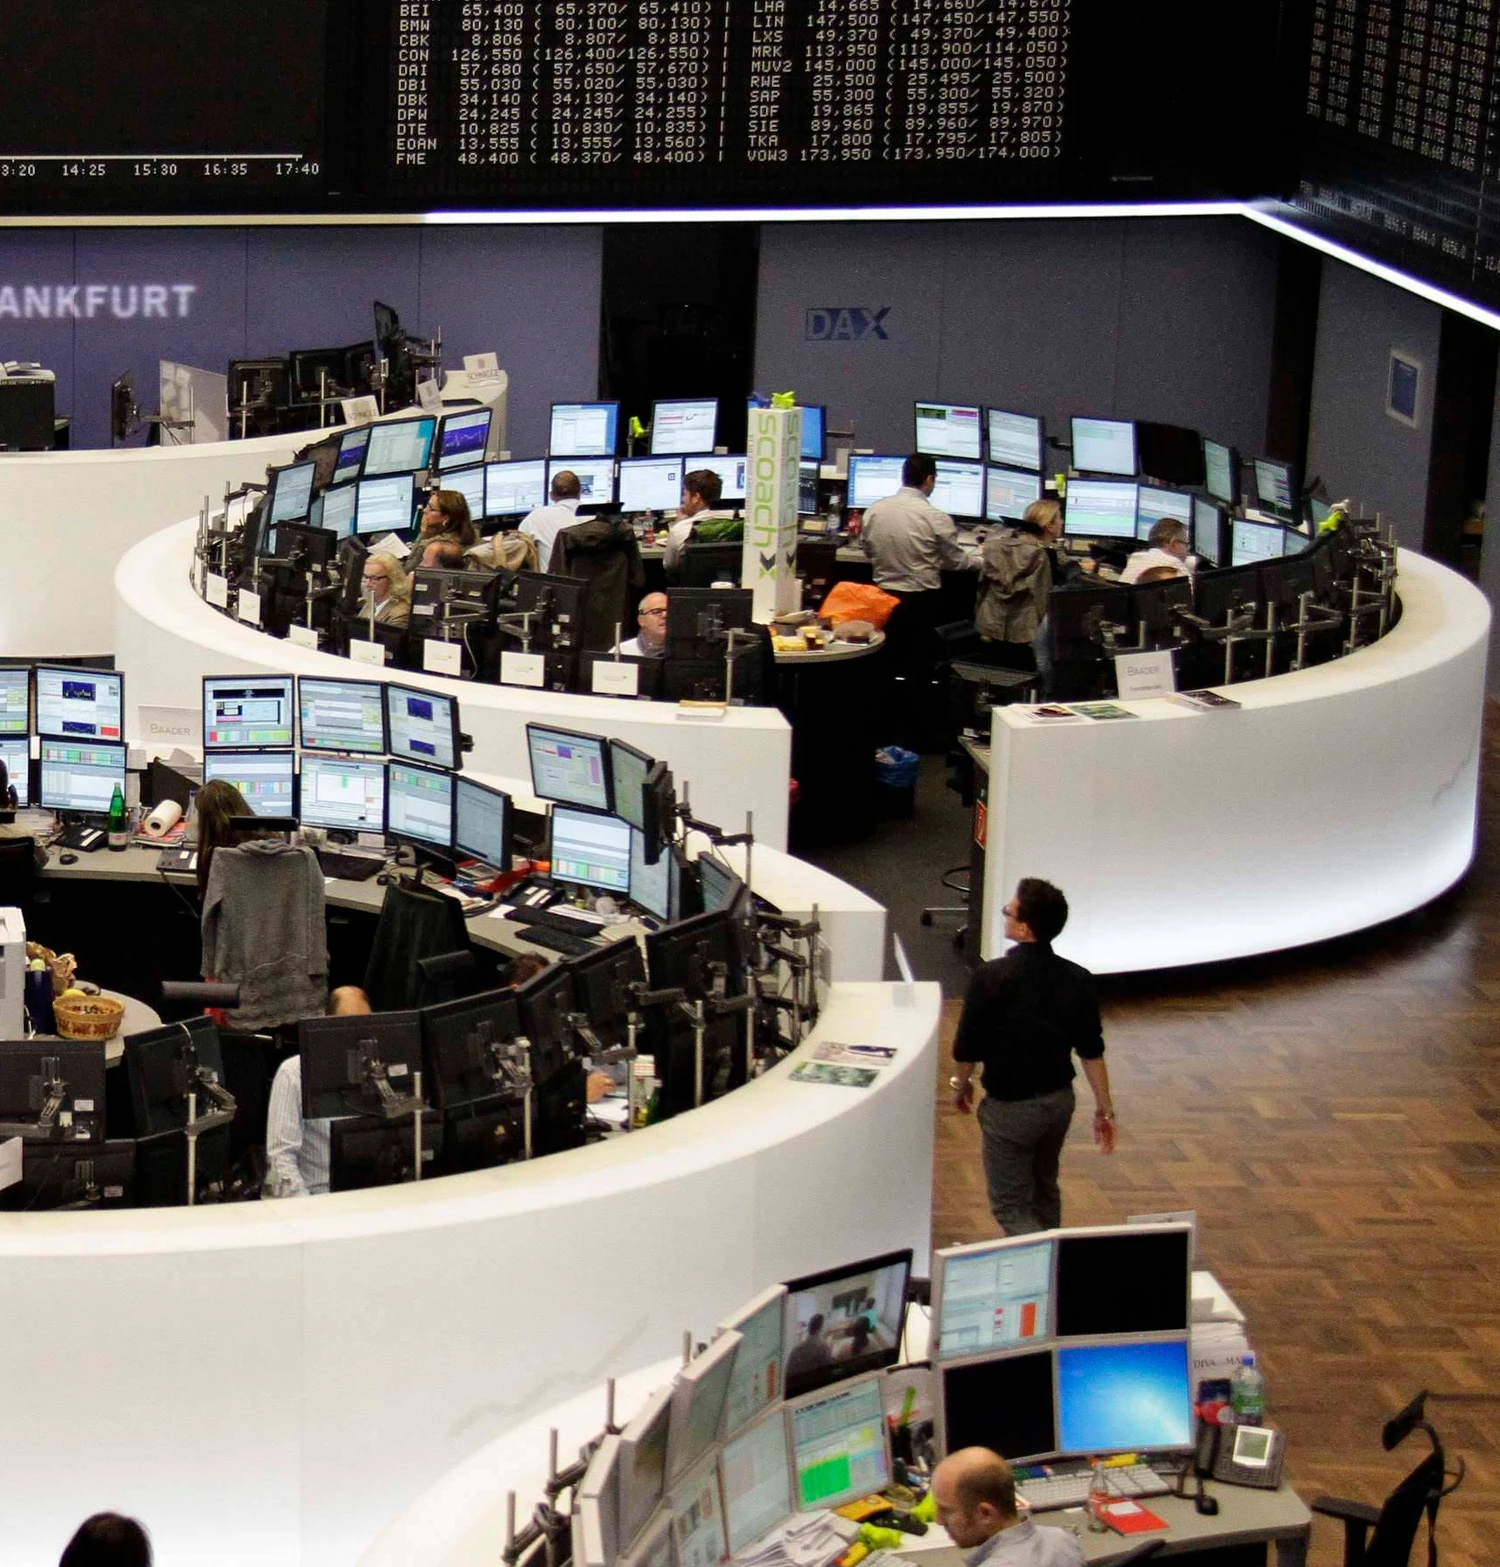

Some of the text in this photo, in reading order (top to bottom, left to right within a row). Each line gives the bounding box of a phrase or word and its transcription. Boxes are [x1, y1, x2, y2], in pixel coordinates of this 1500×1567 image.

[400, 4, 523, 16] BEI 65,400
[755, 0, 879, 12] LHA 14,665
[400, 19, 523, 31] BMW 80,130
[754, 14, 878, 27] LIN 147,500
[400, 34, 522, 46] CBK 8,806
[753, 29, 877, 42] LXS 49,370
[399, 49, 521, 61] CON 126,550
[752, 44, 876, 57] MRK 113,950
[399, 64, 521, 76] DAI 57,680
[752, 59, 875, 72] MUV2 145,000
[461, 79, 520, 90] 55,030
[751, 74, 875, 87] RWE 25,500
[398, 93, 520, 105] DBK 34,140
[751, 89, 873, 102] SAP 55,300
[398, 108, 519, 120] DPW 24,245
[750, 104, 873, 117] SDF 19,865
[397, 123, 519, 135] DTE 10,825
[749, 119, 872, 132] SIE 89,960
[460, 138, 519, 149] 13,555
[749, 134, 871, 146] TKA 17,800
[397, 153, 518, 164] FME 48,400
[748, 149, 870, 161] VOW3 173,950
[63, 164, 105, 176] 14:25
[135, 164, 177, 175] 15:30
[205, 163, 247, 175] 16:35
[277, 163, 318, 174] 17:40
[805, 306, 891, 342] DAX
[753, 413, 778, 548] scoach
